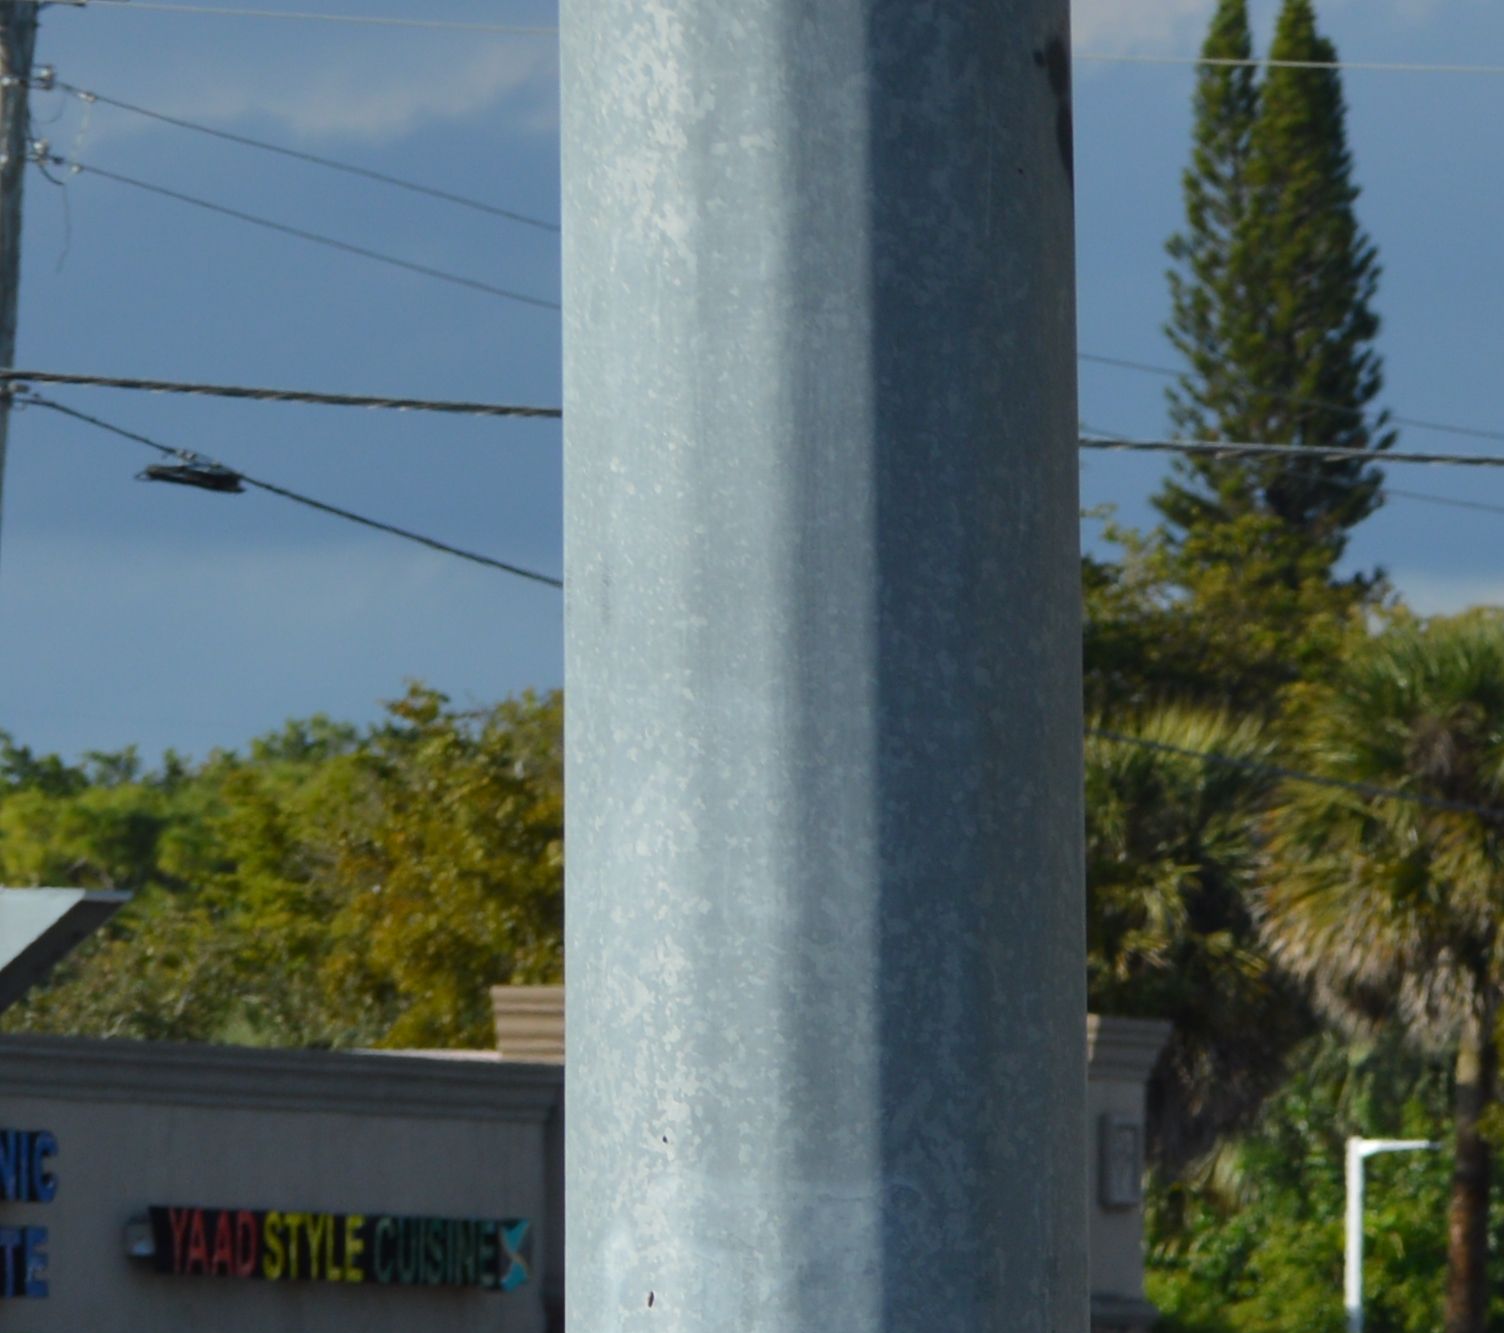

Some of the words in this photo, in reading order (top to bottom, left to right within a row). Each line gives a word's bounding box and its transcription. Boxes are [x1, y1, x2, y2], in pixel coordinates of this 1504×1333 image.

[170, 1208, 256, 1276] YAAD
[263, 1210, 364, 1283] STYLE
[372, 1216, 500, 1288] CUISINE
